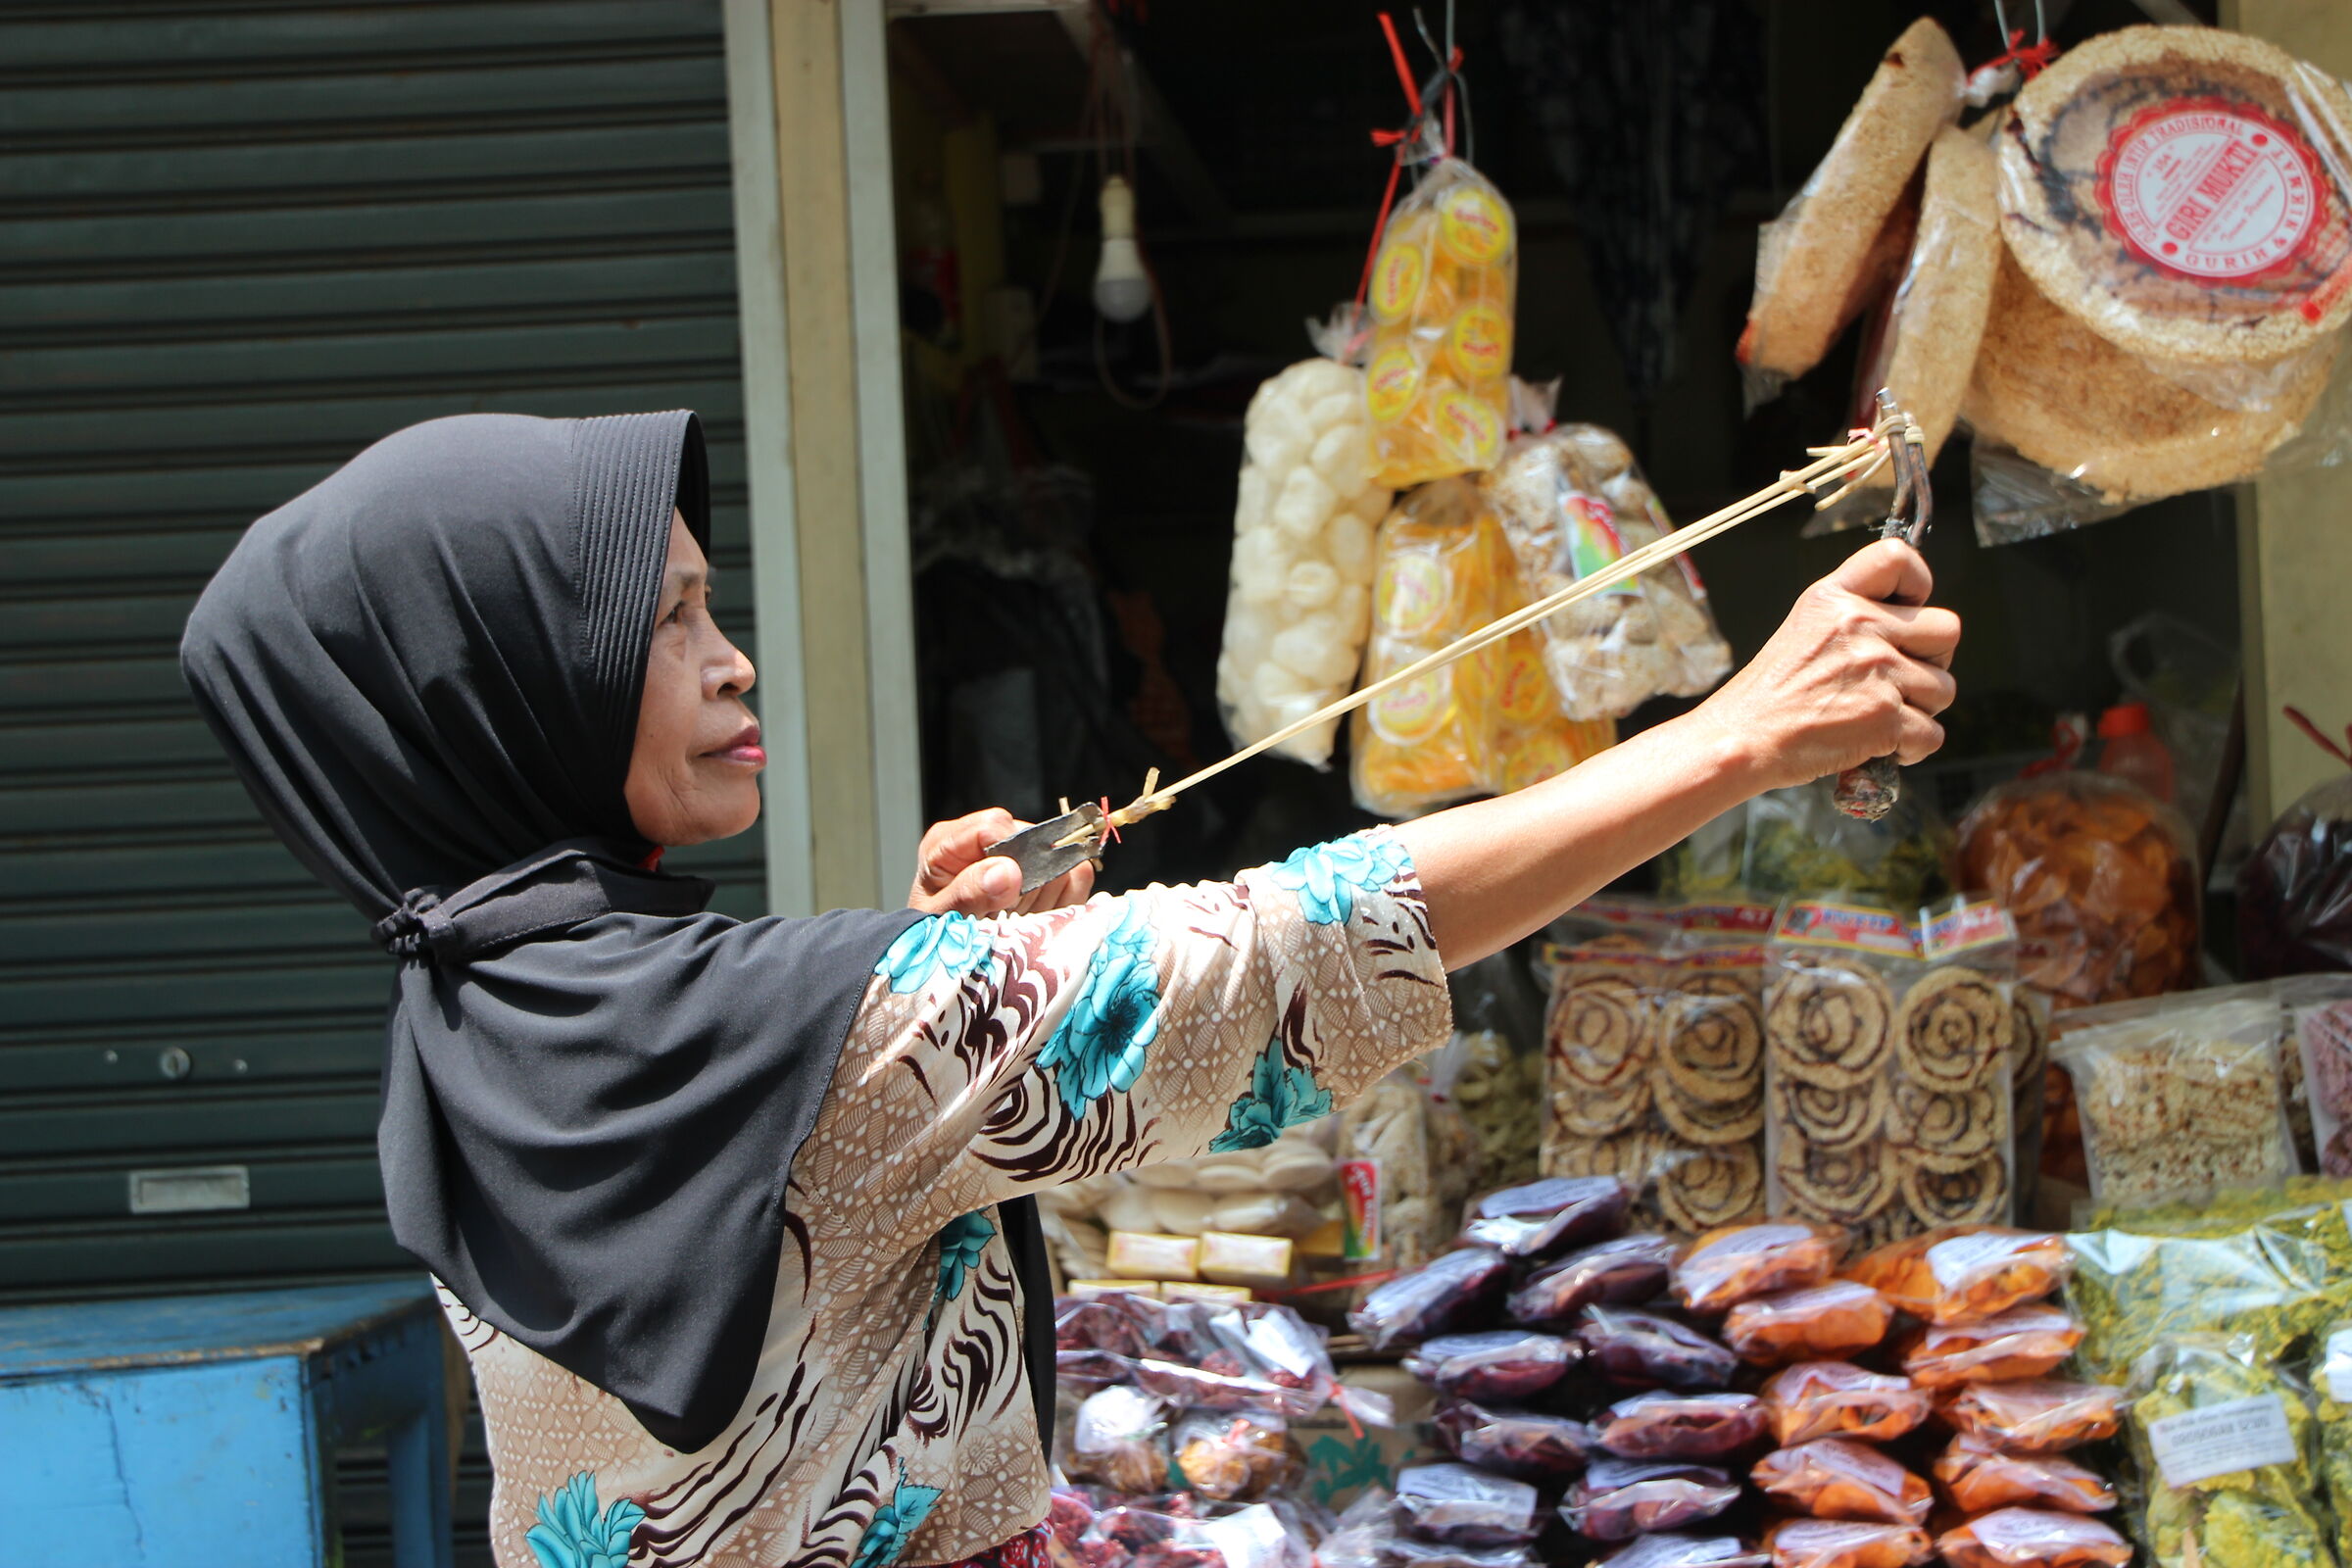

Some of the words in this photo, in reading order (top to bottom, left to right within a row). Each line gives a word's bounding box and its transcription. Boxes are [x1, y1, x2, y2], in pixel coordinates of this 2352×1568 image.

[2148, 116, 2242, 142] TRADISIONAL
[2166, 195, 2212, 241] GIRI
[2195, 139, 2259, 203] MUKTI
[2184, 248, 2268, 270] GURIH
[2270, 149, 2306, 231] NIKMAT
